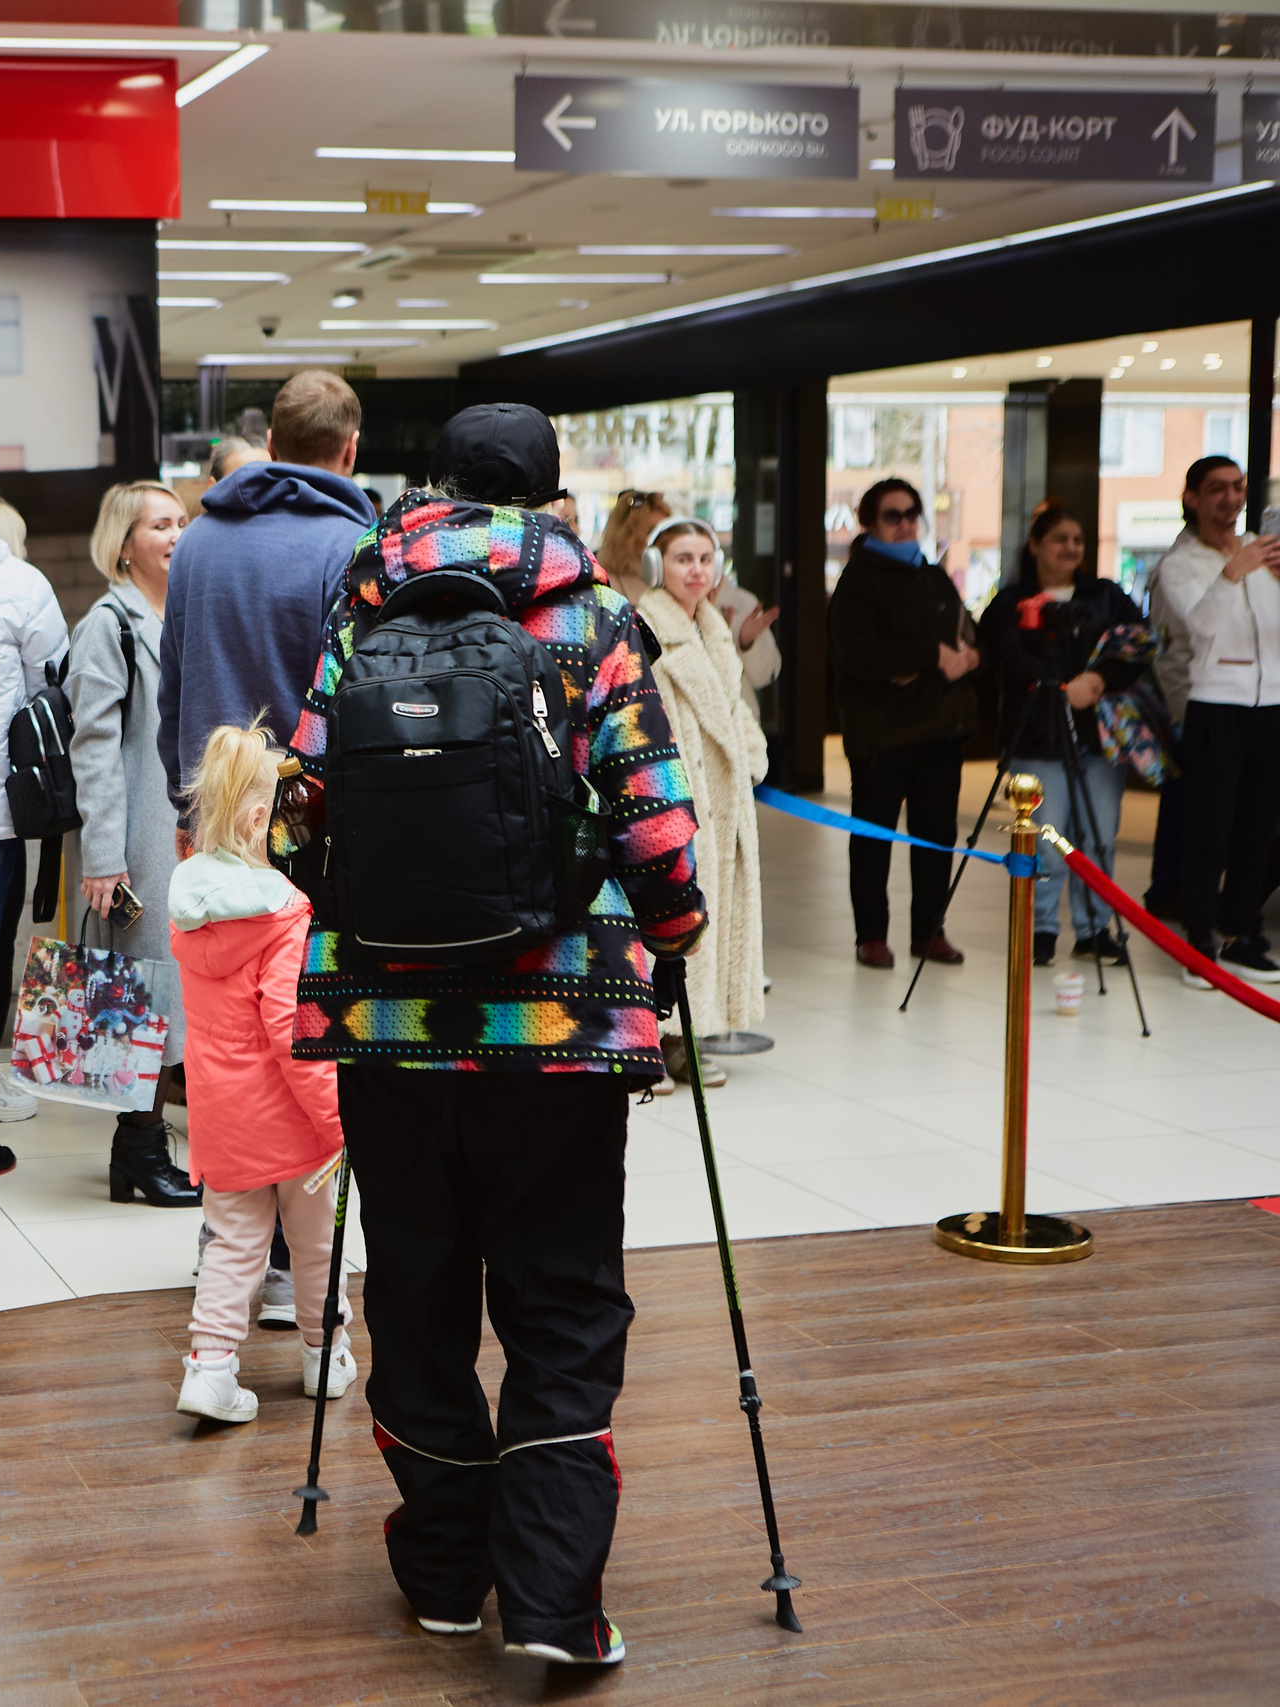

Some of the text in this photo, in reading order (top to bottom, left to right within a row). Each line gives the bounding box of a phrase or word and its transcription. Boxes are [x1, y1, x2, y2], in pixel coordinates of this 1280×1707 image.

[654, 107, 829, 137] УЛ. ГОРЬКОГО
[980, 115, 1117, 143] ФУД-КОРТ
